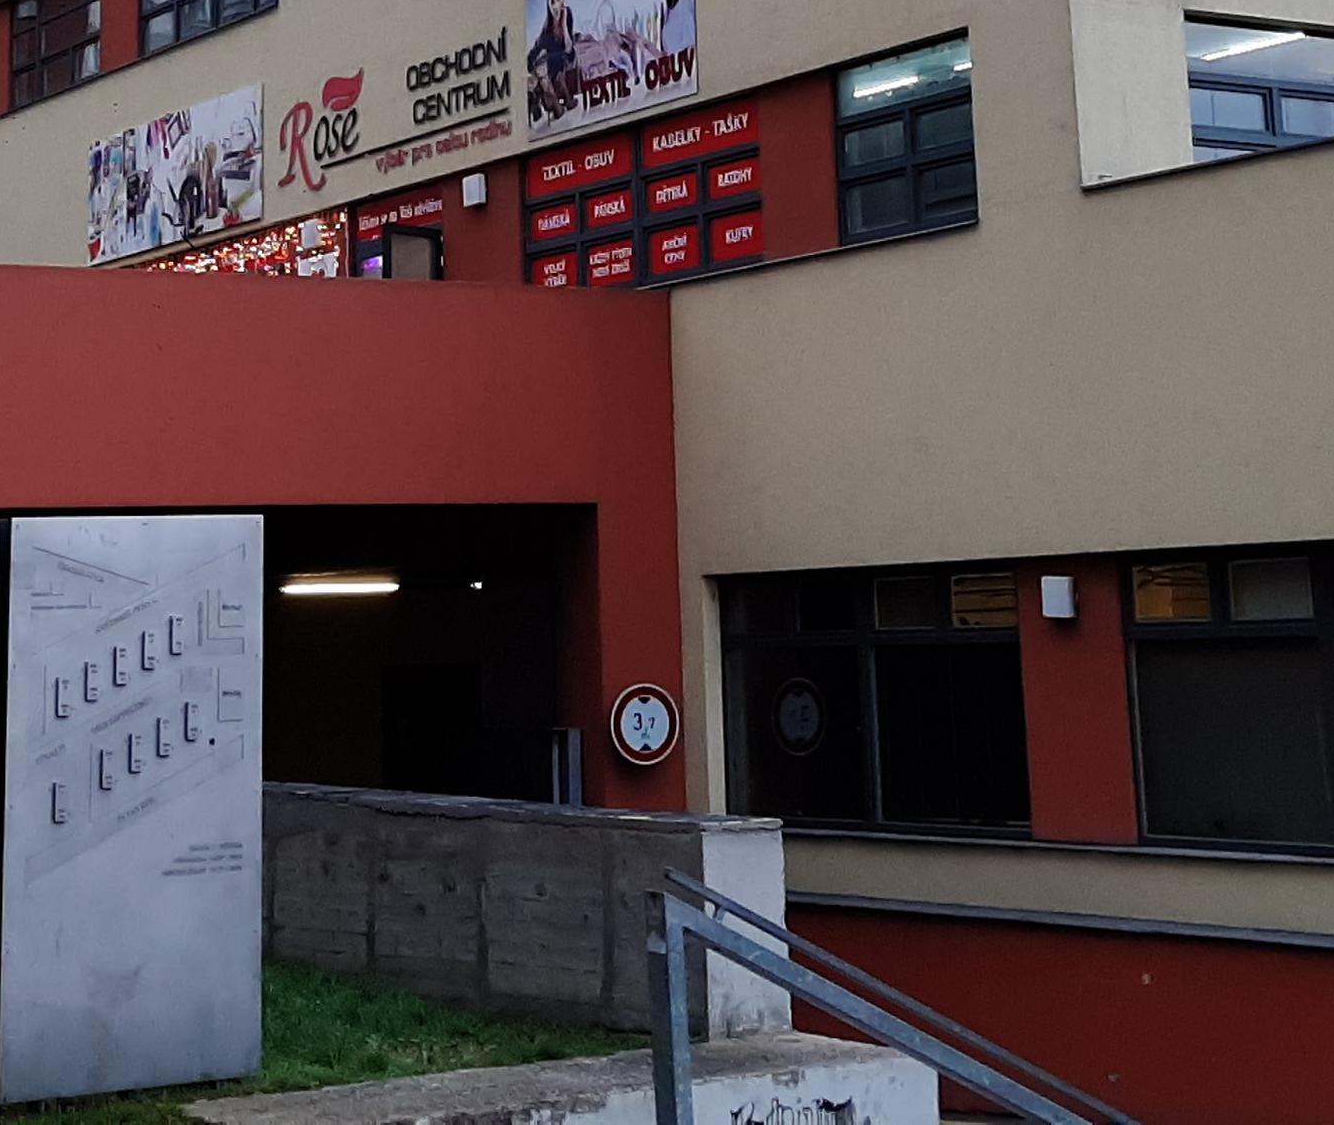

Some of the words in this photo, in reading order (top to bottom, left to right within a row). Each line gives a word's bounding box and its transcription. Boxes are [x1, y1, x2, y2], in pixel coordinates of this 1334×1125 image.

[406, 26, 509, 92] OBCHODNÍ
[580, 69, 632, 111] TEXTIL
[645, 47, 695, 91] OBUV
[413, 70, 512, 125] CENTRUM
[278, 101, 360, 191] Rose
[542, 159, 576, 181] TEXTIL
[584, 148, 615, 170] OBUV
